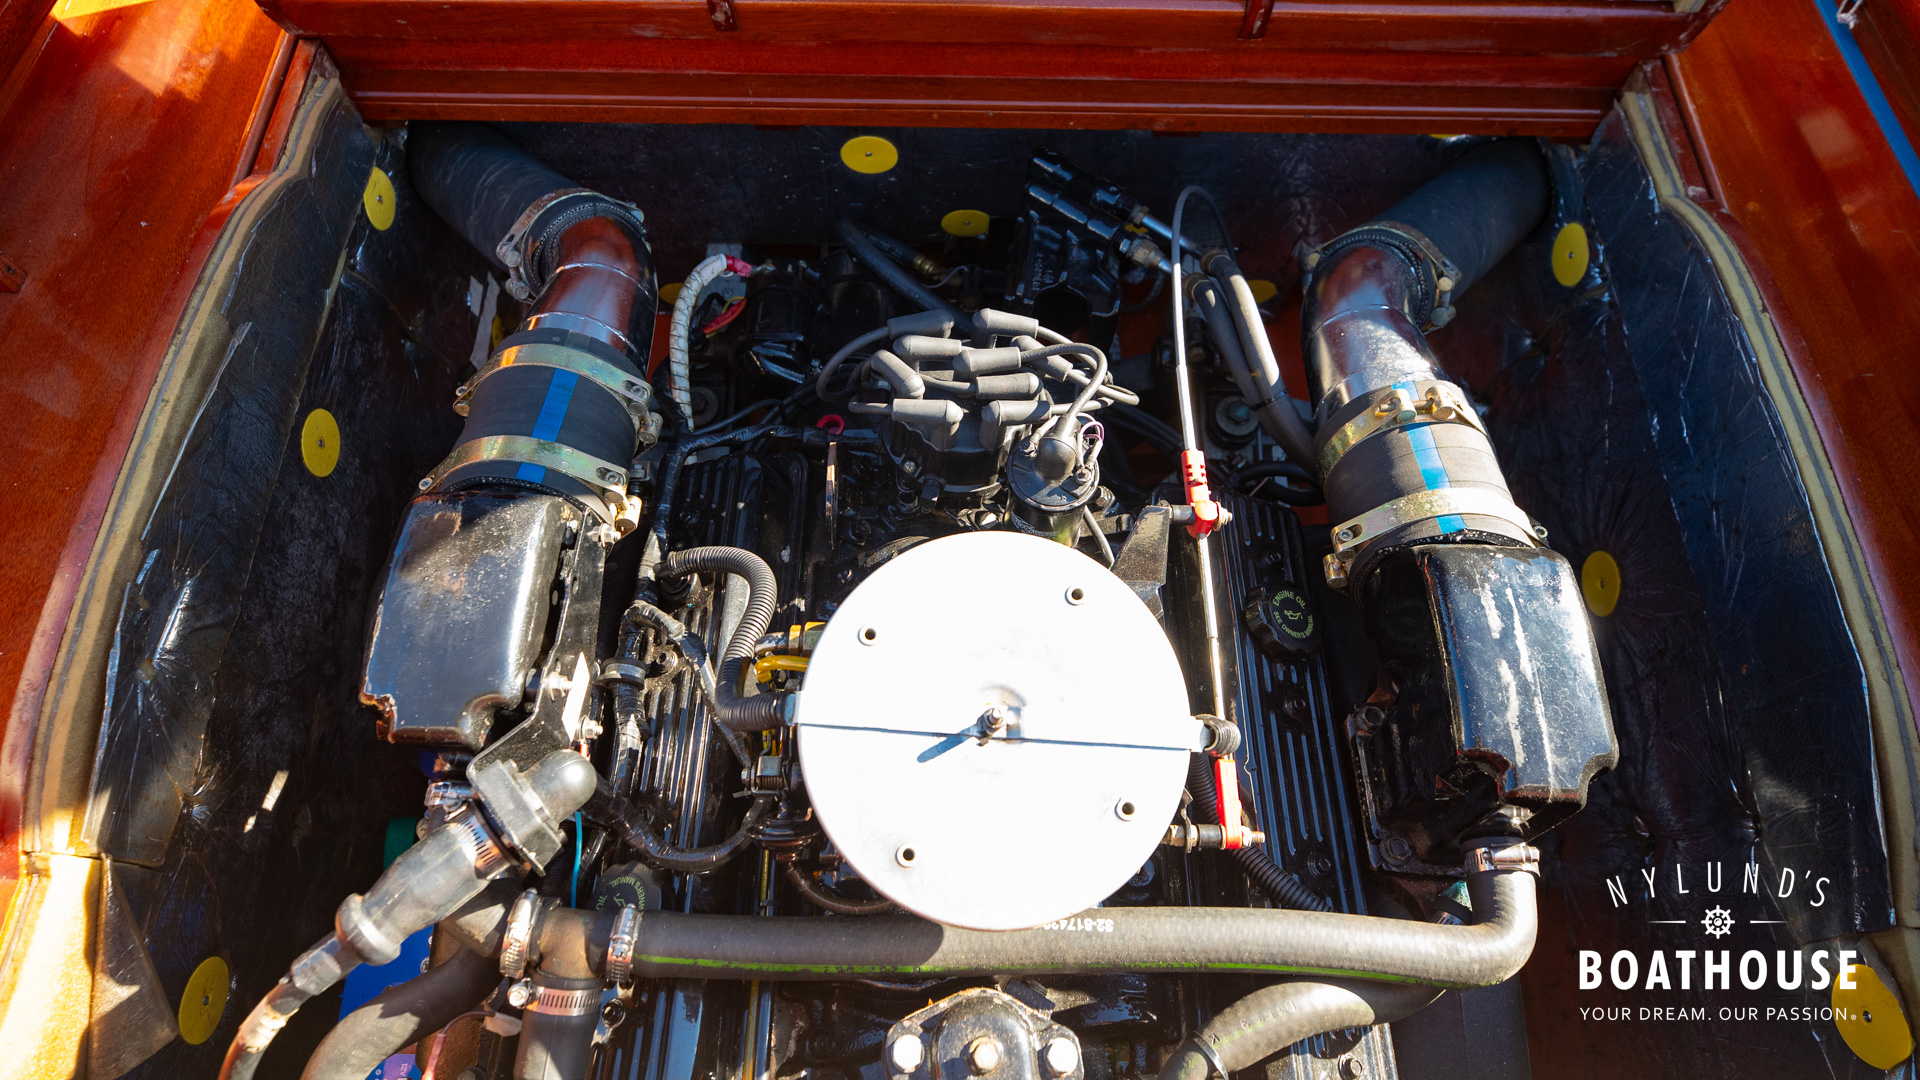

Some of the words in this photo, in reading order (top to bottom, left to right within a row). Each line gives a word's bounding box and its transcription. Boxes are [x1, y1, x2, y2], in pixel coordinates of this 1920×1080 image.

[1272, 590, 1295, 606] ENGINE
[1295, 596, 1307, 609] OIL
[1273, 611, 1283, 625] SEE
[1281, 624, 1306, 639] OWNER'S
[1304, 614, 1314, 637] MANUAL
[609, 876, 637, 888] MANUAL
[634, 881, 646, 910] WNER'S
